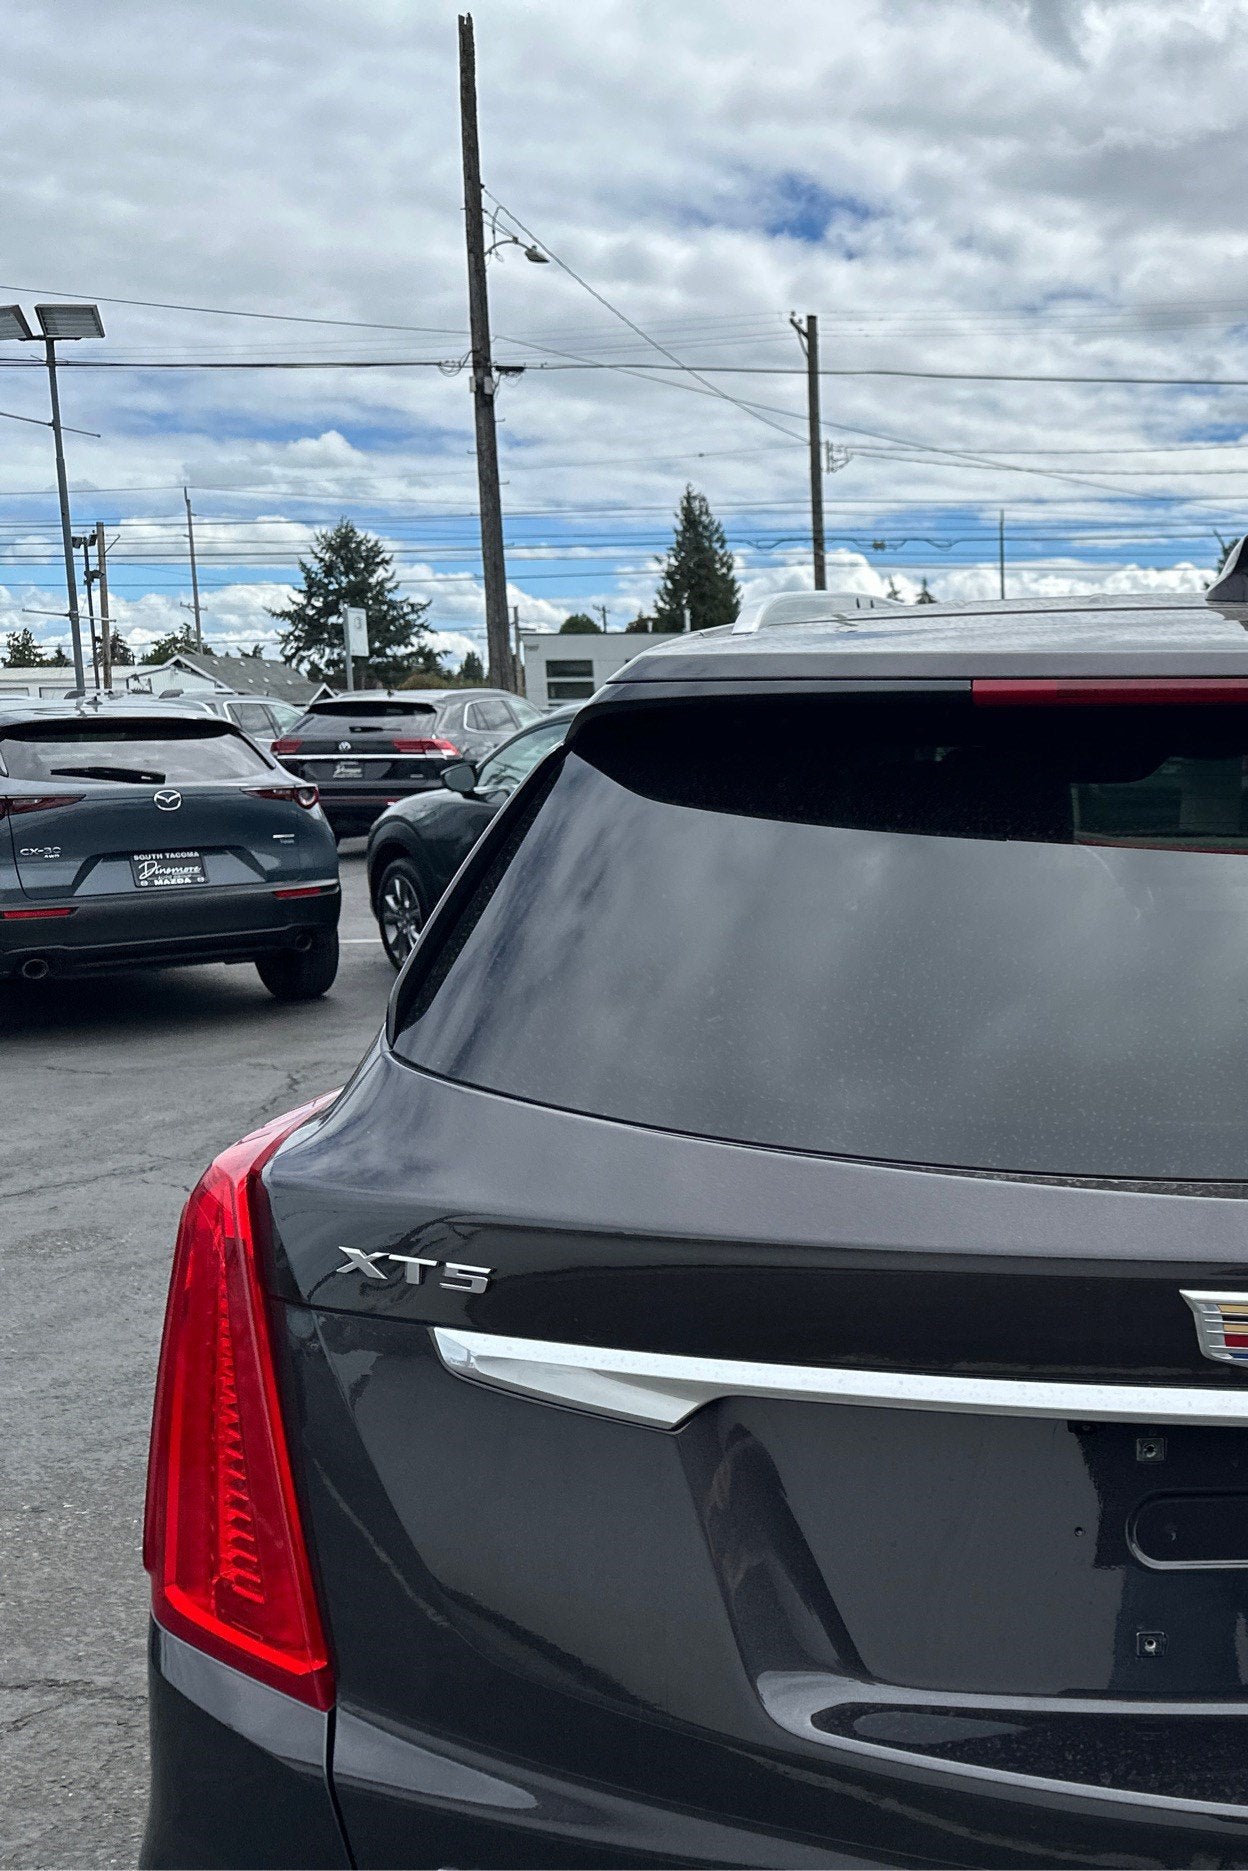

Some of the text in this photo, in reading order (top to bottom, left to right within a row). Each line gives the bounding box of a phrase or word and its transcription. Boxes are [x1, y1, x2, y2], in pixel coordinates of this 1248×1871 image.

[133, 851, 200, 861] SOUTH TACOMA
[153, 877, 193, 886] MAZDA
[336, 1246, 493, 1295] XT5
